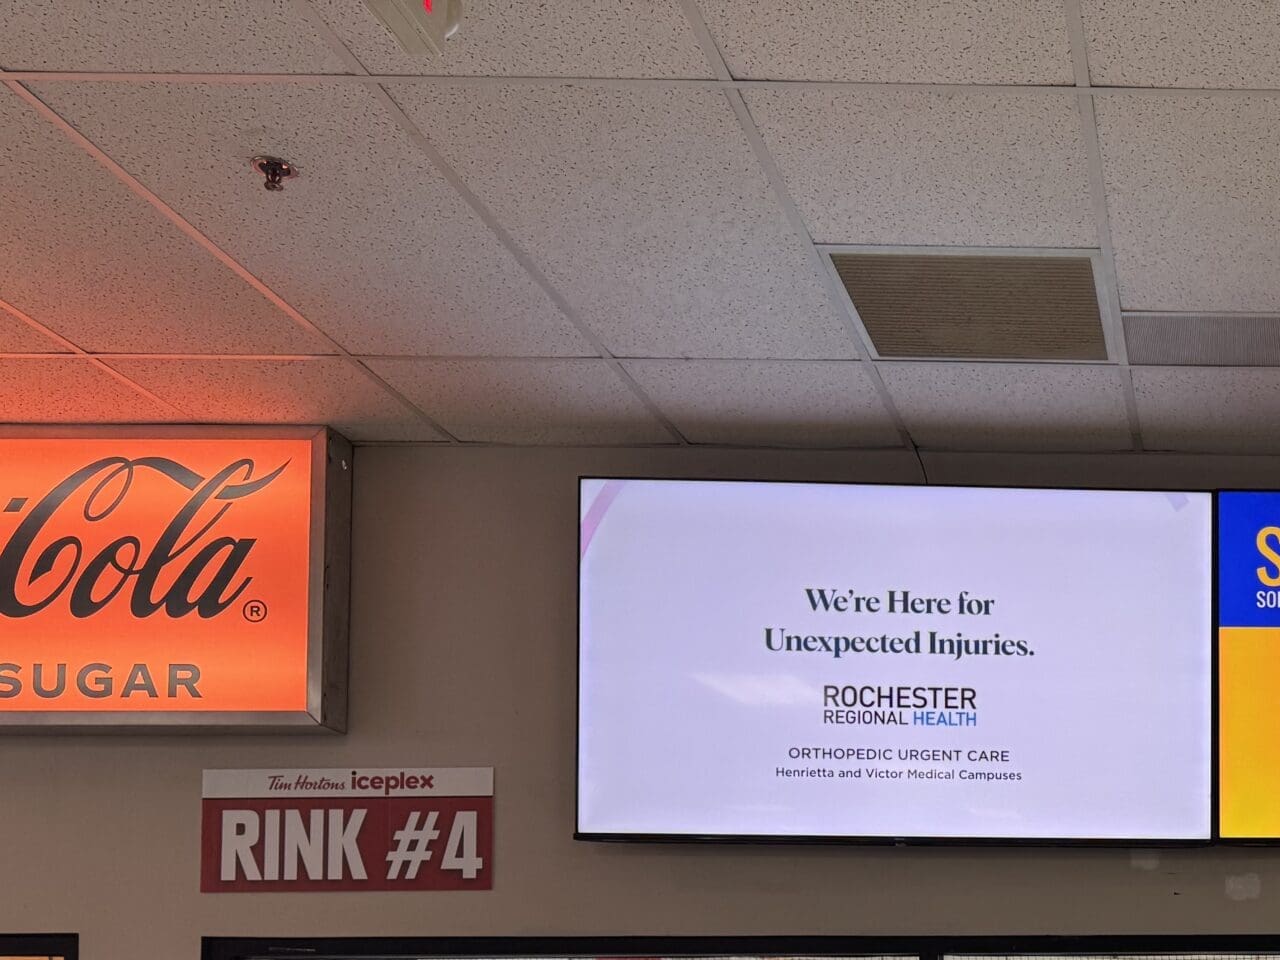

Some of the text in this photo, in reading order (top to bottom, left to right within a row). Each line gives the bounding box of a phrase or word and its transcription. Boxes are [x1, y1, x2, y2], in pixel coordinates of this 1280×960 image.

[804, 588, 996, 616] We're Here for
[764, 628, 1036, 661] Unexpected Injuries.
[0, 662, 203, 699] SUGAR
[823, 684, 977, 710] ROCHESTER
[823, 710, 977, 727] REGIONAL HEALTH
[788, 747, 1011, 763] ORTHOPEDIC URGENT CARE
[266, 770, 435, 795] Tim Hortons iceplex
[775, 767, 1022, 782] Henrietta and Victor Medical Campuses
[220, 808, 484, 882] RINK #4
